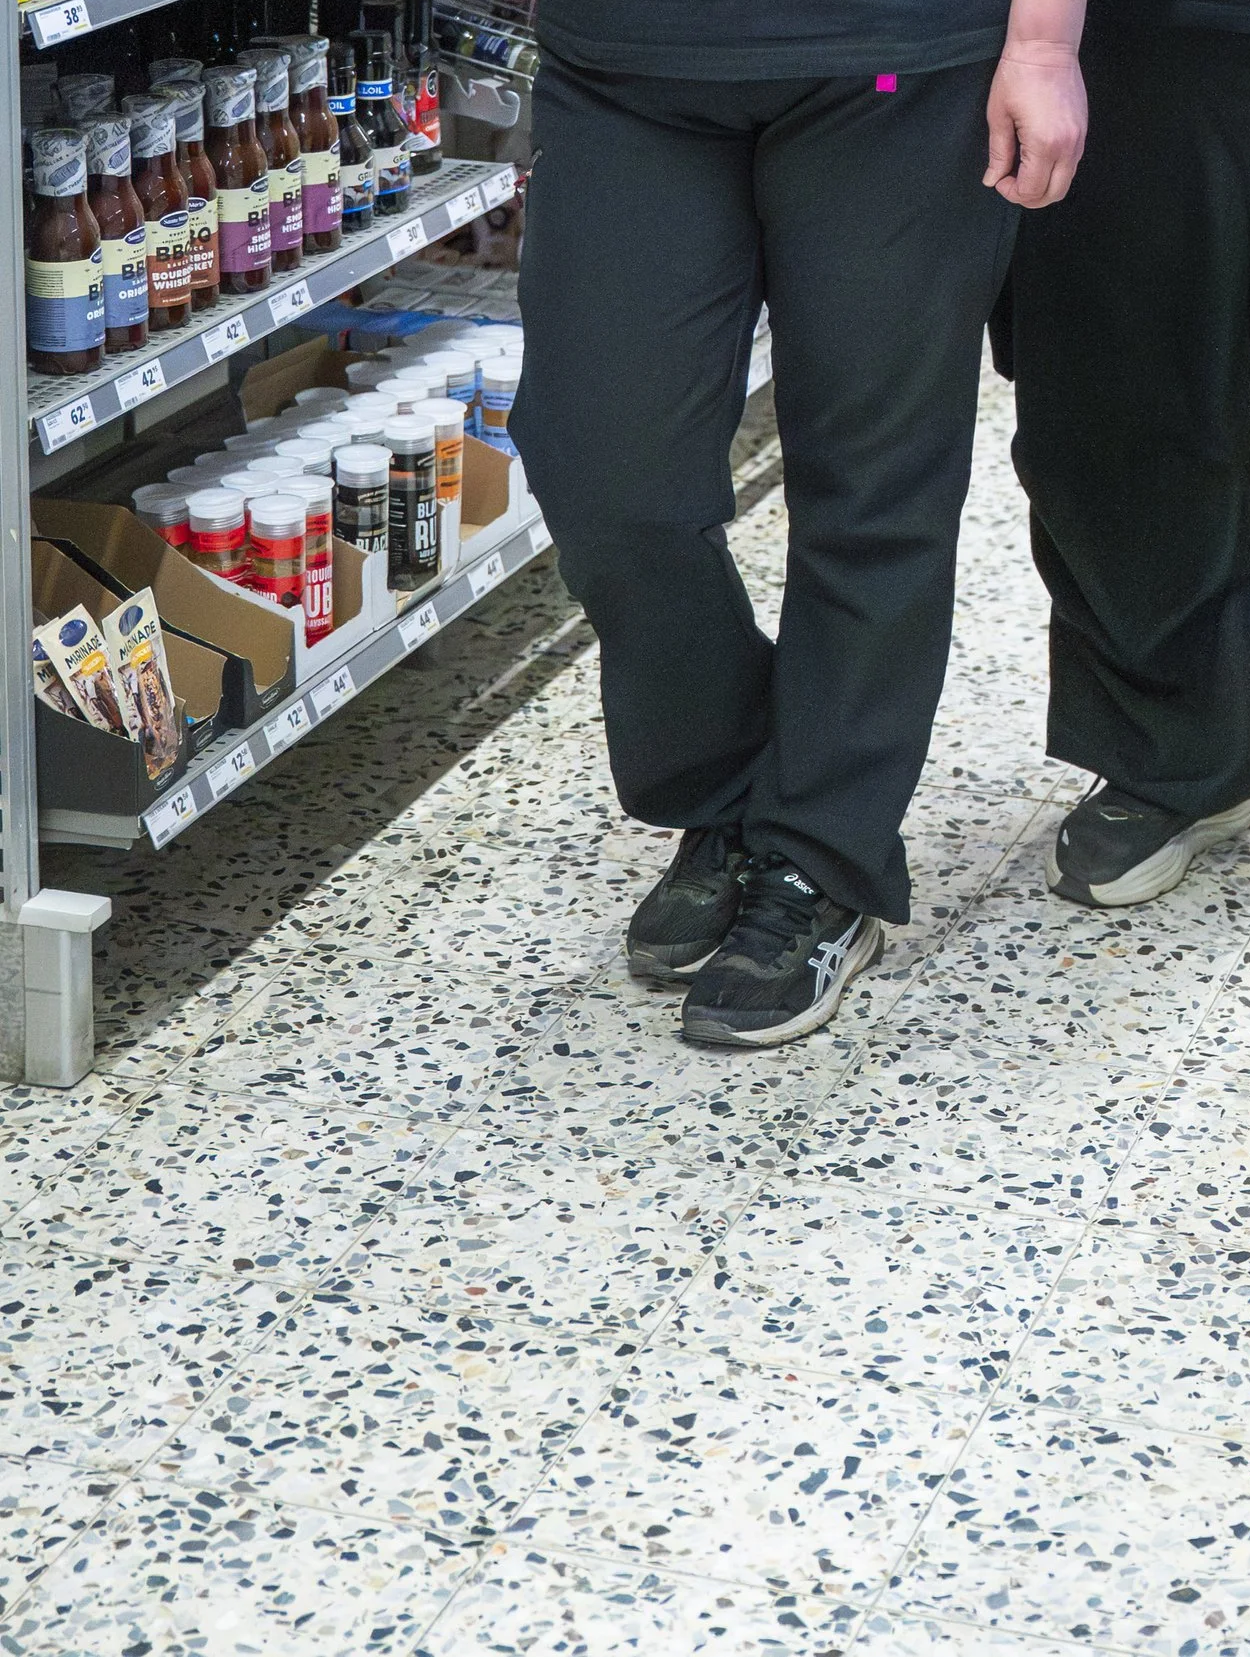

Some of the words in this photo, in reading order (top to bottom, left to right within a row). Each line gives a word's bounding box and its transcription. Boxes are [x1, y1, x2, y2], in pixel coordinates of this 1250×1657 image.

[64, 8, 78, 26] 38
[189, 259, 214, 272] SKEY
[190, 250, 214, 263] RBON
[152, 267, 191, 282] BOURB
[356, 532, 388, 553] BLAC
[415, 516, 437, 551] RU
[305, 581, 333, 619] UB
[119, 620, 157, 661] MARINADE
[64, 634, 102, 670] MARINADE
